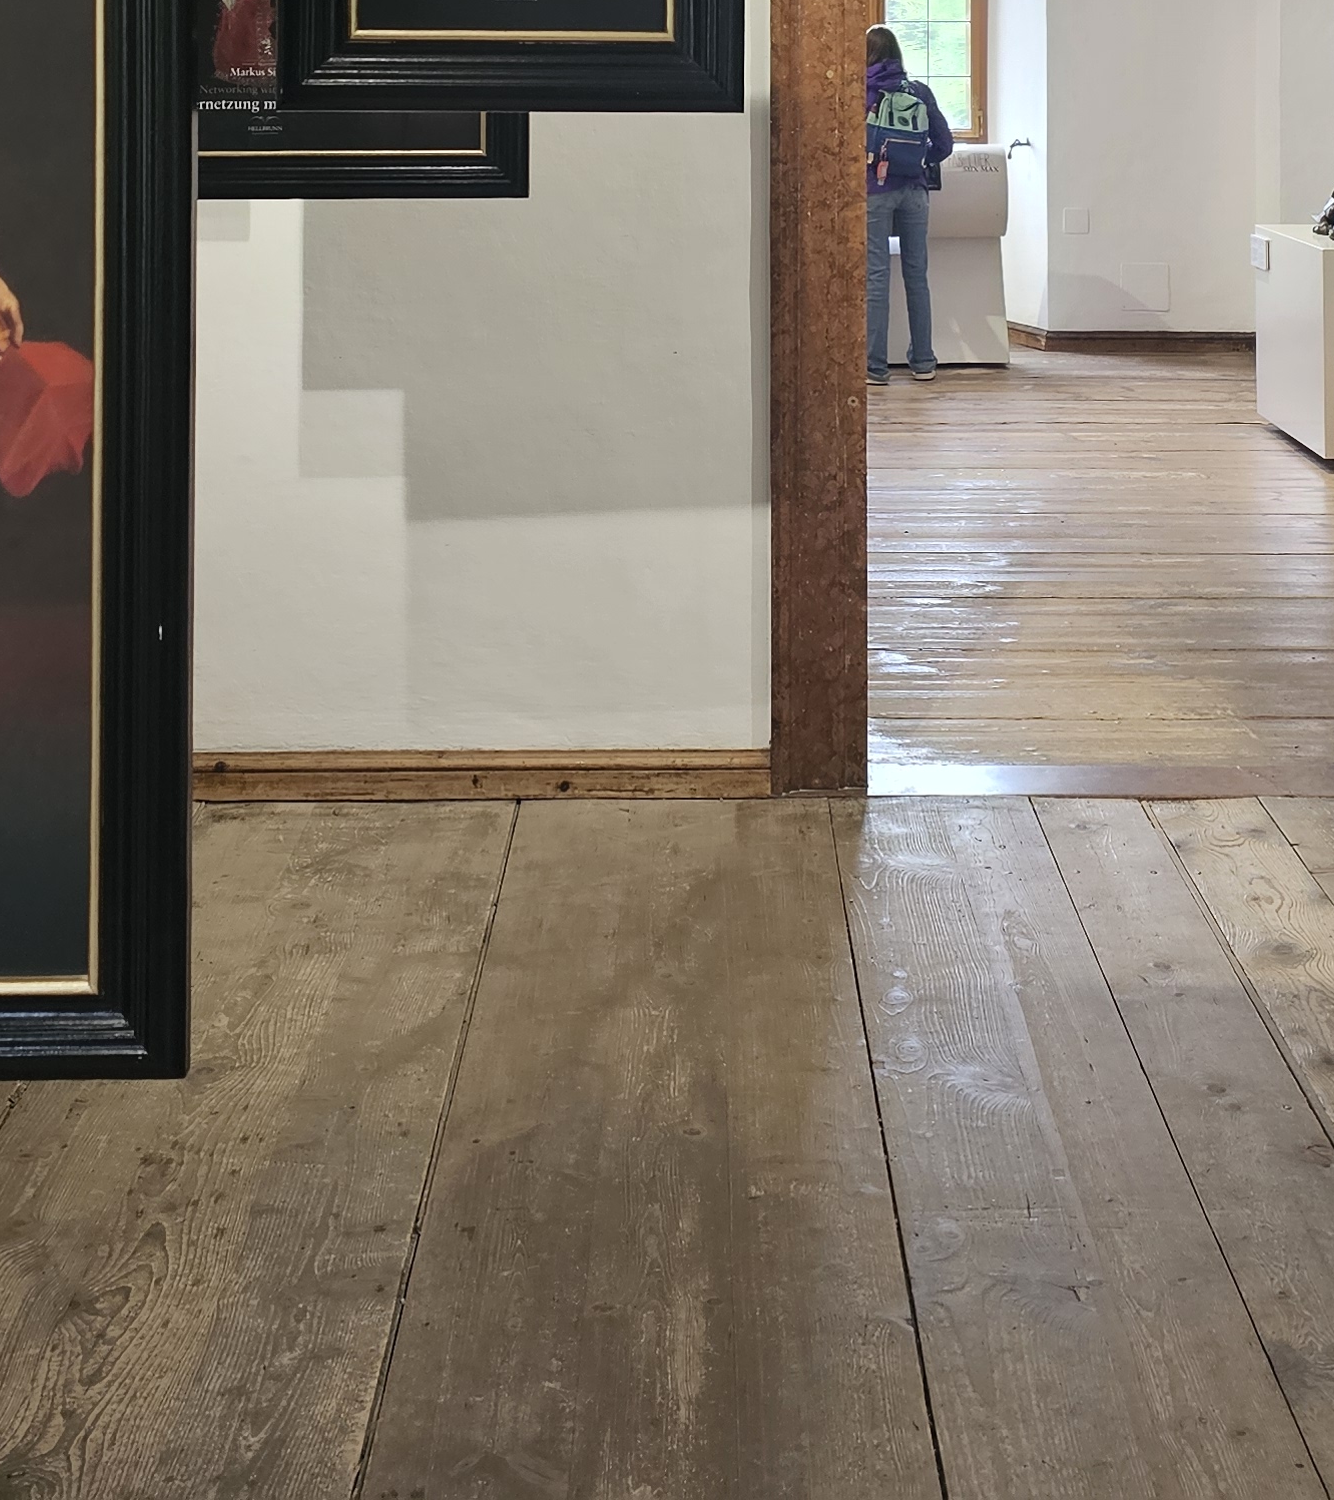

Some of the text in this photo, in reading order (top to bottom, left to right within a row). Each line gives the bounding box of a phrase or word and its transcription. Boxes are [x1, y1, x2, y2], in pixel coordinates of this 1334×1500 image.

[230, 67, 265, 77] Markus
[199, 85, 259, 96] Networking
[197, 100, 260, 114] rnetzung
